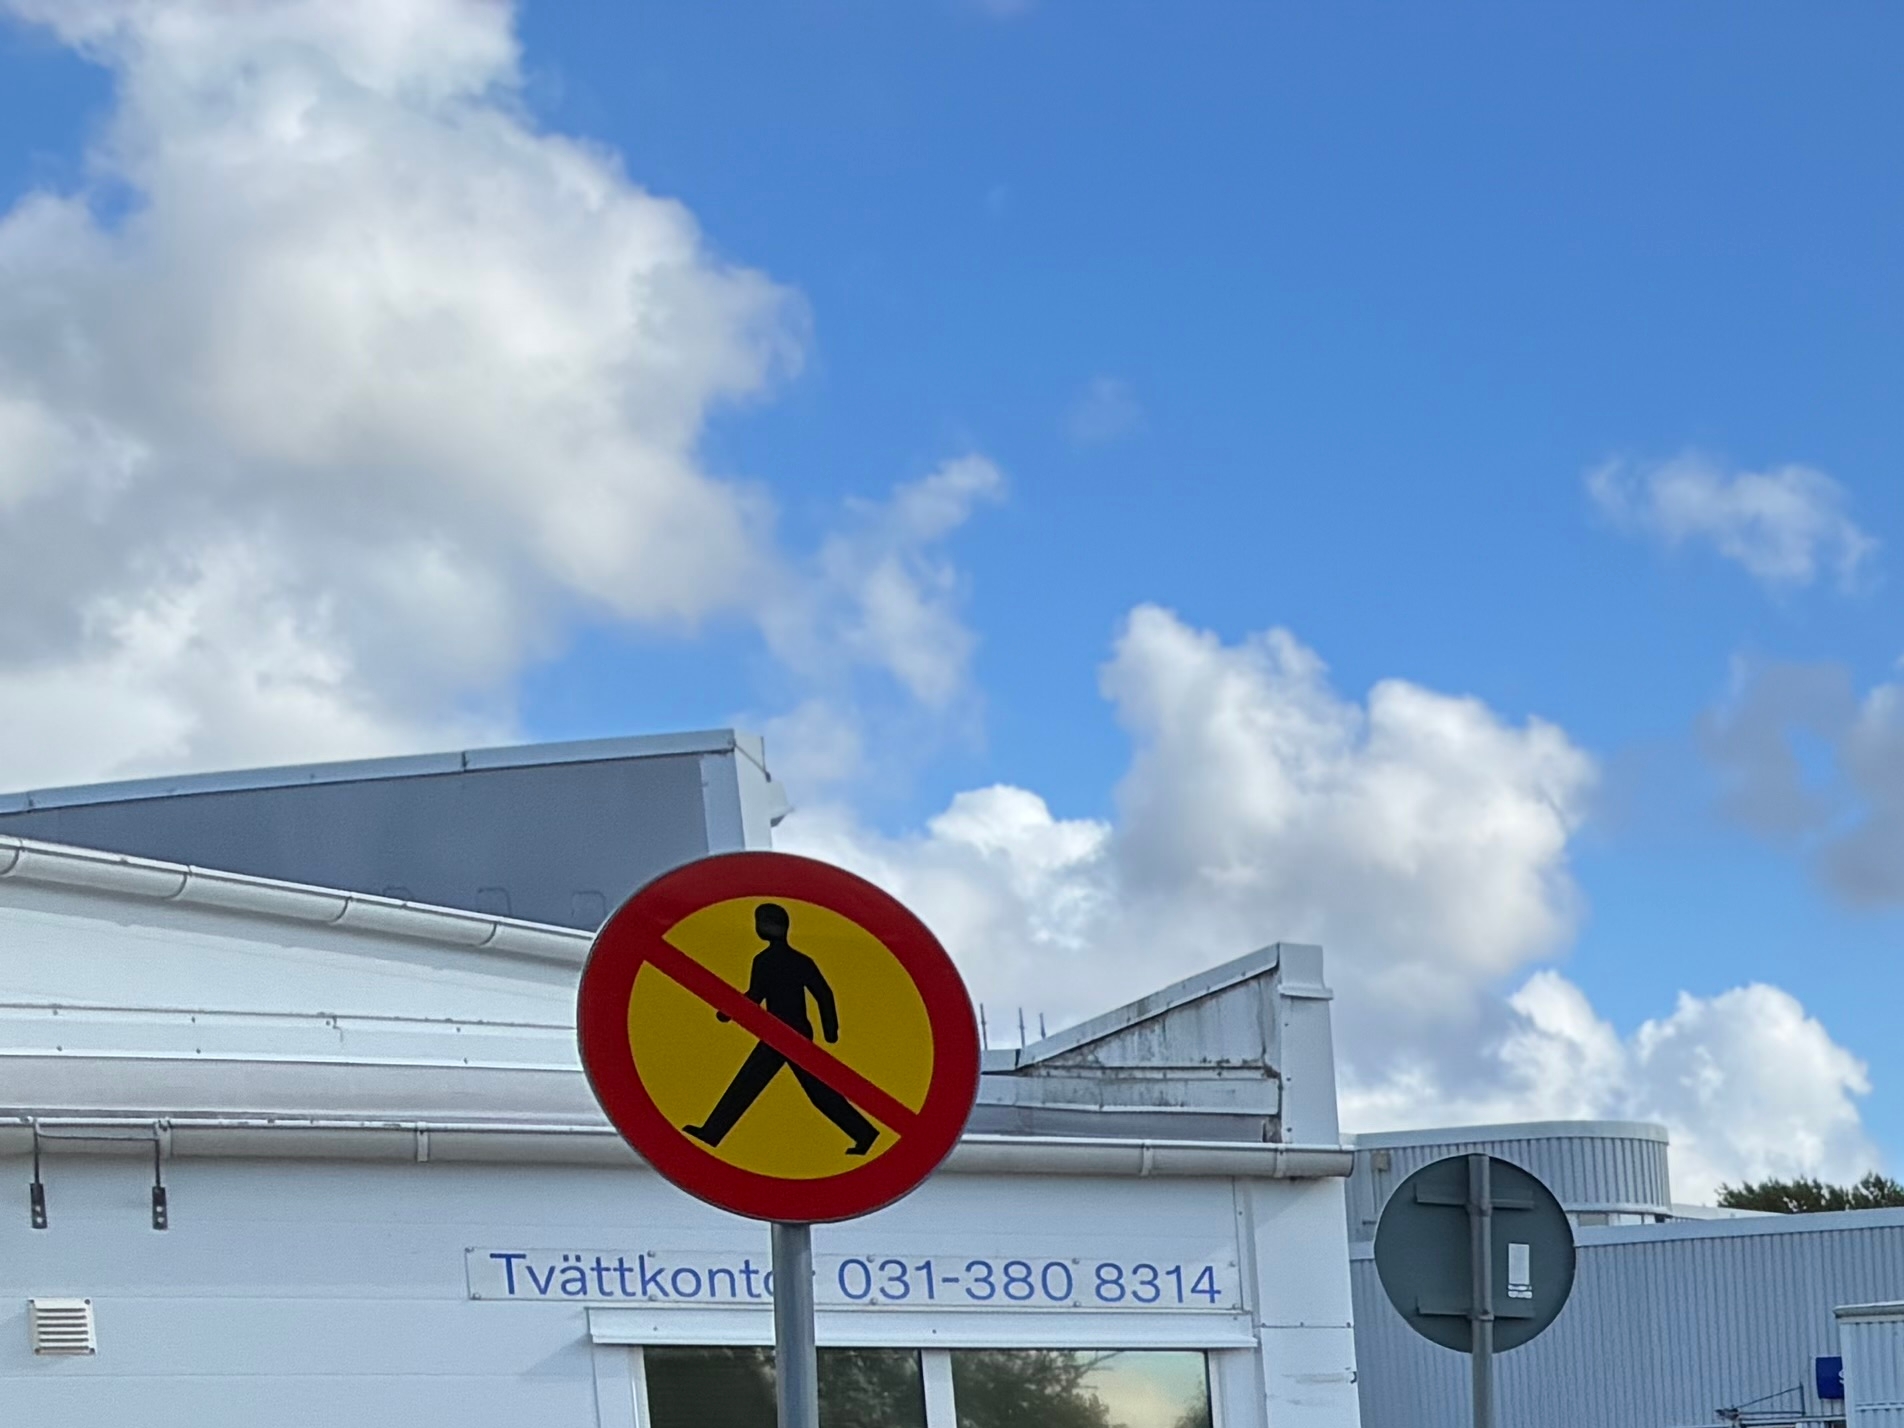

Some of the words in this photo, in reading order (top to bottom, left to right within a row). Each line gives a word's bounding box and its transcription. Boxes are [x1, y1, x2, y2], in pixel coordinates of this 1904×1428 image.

[489, 1253, 816, 1298] Tvättkont
[838, 1258, 1073, 1301] 031-380
[1095, 1262, 1222, 1304] 8314
